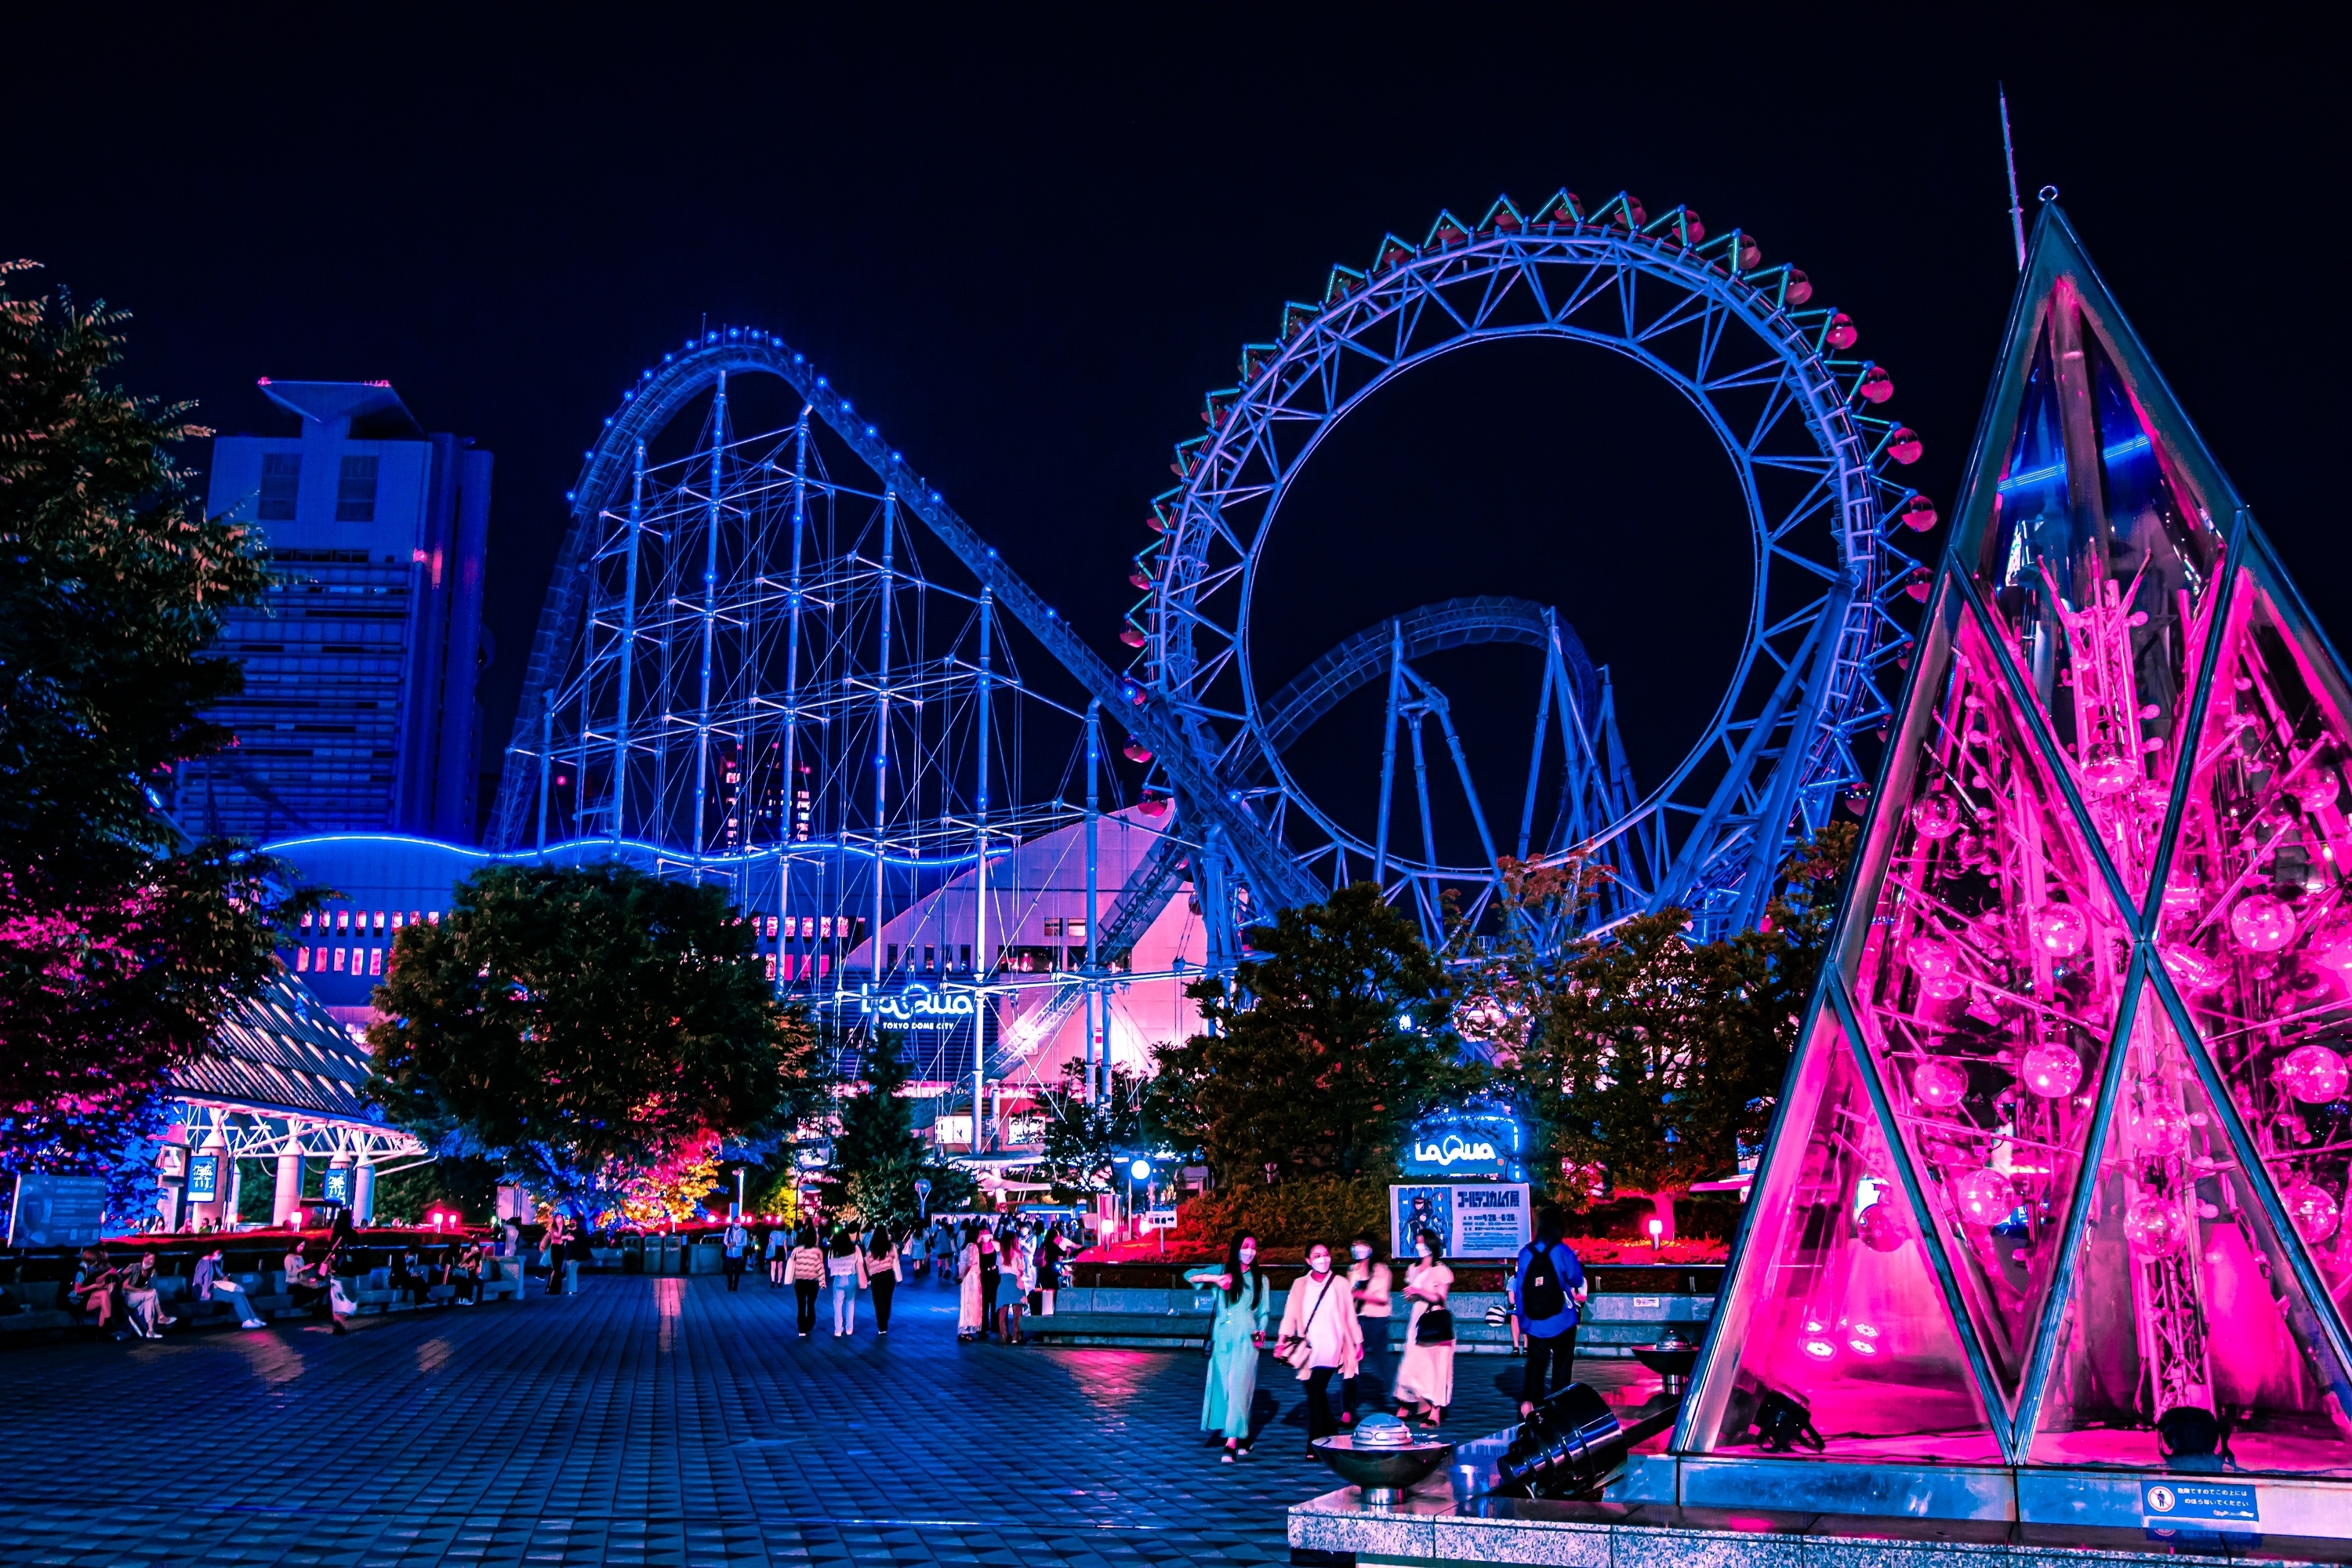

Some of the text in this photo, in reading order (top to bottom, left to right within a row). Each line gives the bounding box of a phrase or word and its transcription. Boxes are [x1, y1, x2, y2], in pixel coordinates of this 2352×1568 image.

[1414, 1135, 1496, 1165] LaQua
[1457, 1190, 1519, 1207] ゴールデンカムイ展
